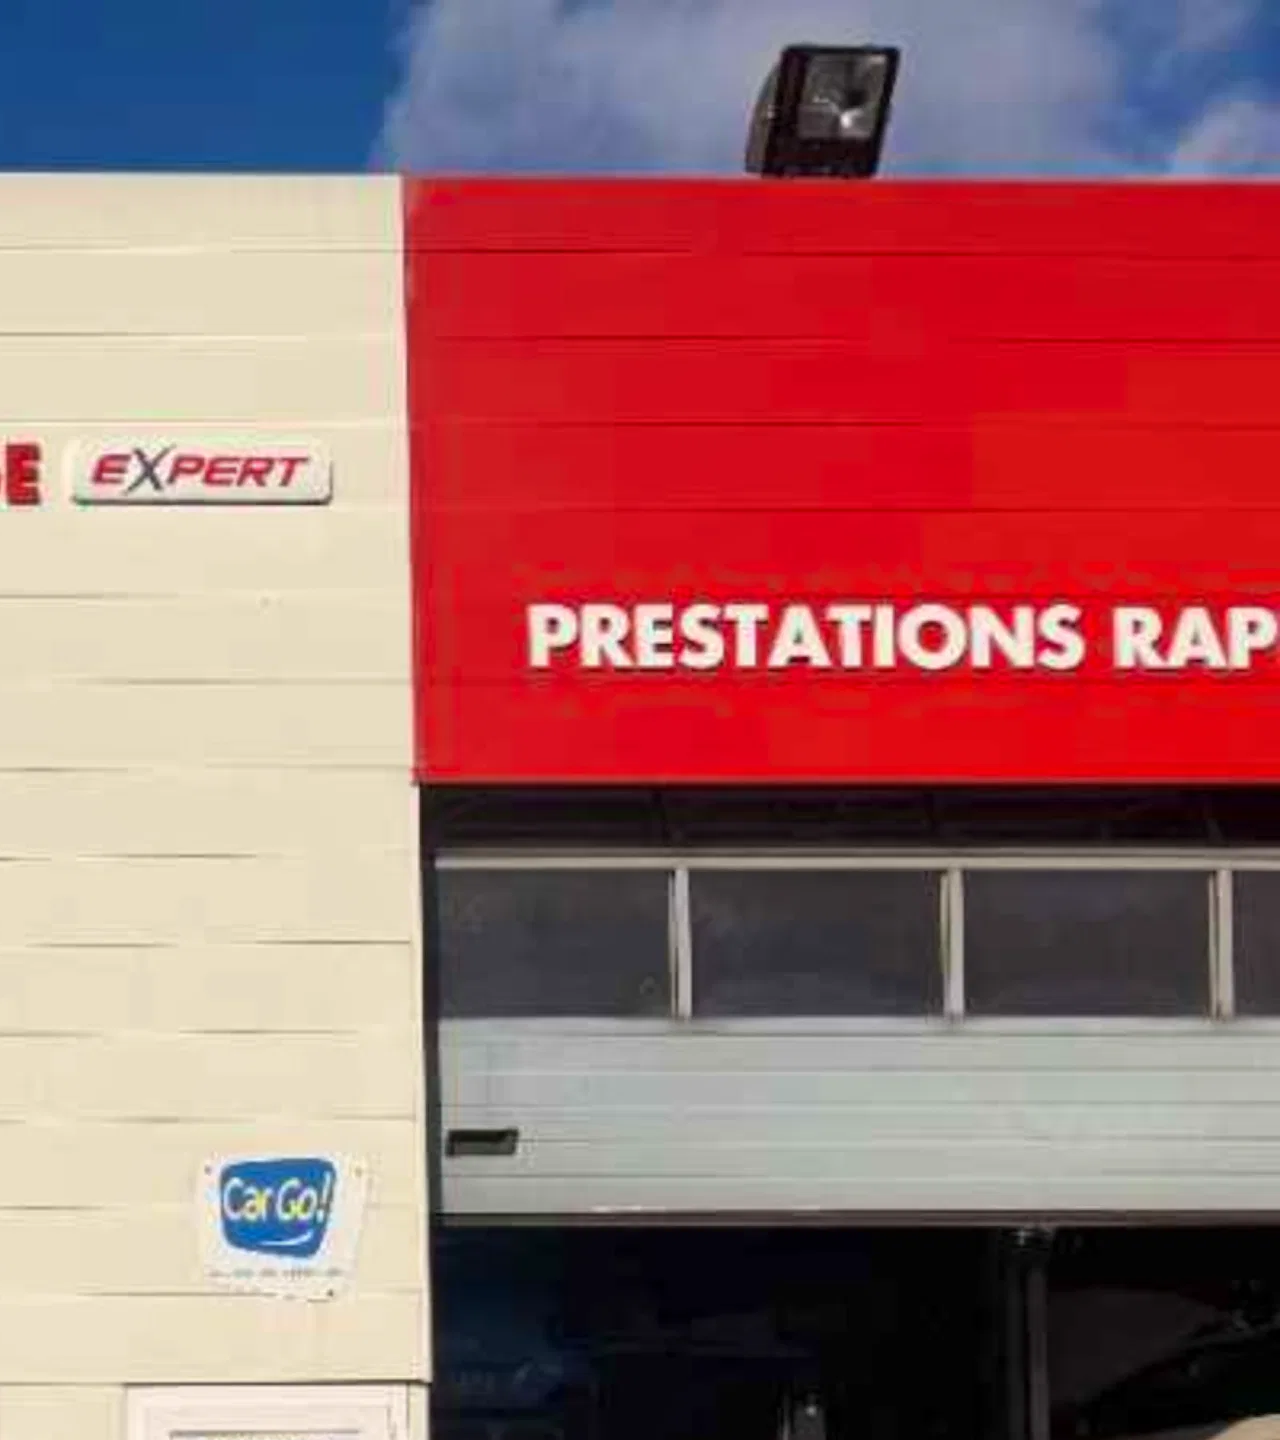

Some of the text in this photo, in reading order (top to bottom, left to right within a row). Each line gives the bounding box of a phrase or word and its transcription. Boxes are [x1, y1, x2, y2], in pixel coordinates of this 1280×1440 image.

[91, 444, 309, 495] EXPERT
[527, 603, 1279, 670] PRESTATIONS RAP
